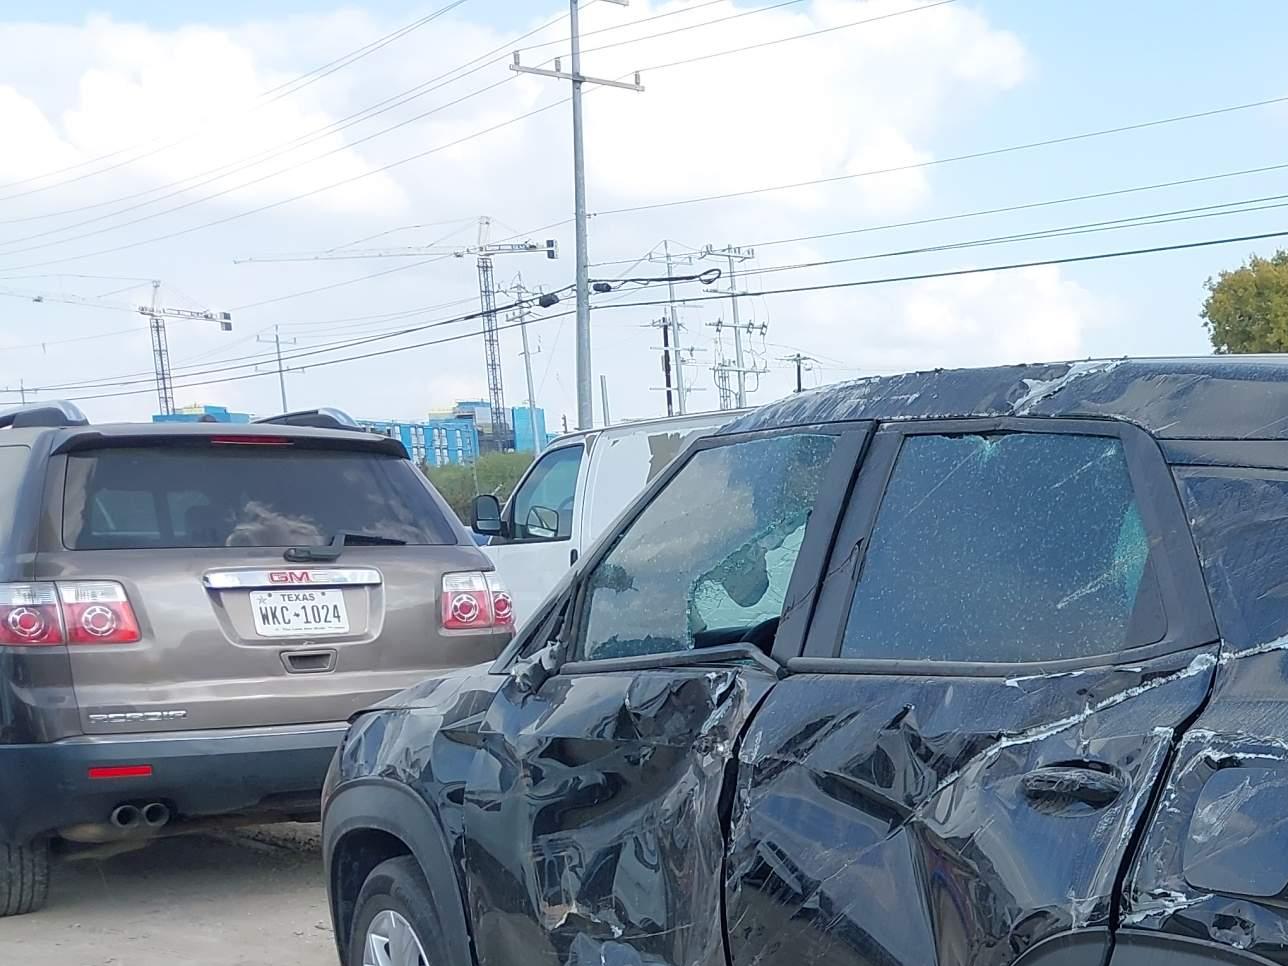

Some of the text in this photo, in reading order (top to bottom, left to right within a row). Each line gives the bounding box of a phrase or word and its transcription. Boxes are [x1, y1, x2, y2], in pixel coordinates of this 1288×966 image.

[280, 593, 315, 602] TEXAS
[259, 604, 341, 625] WKC 1024
